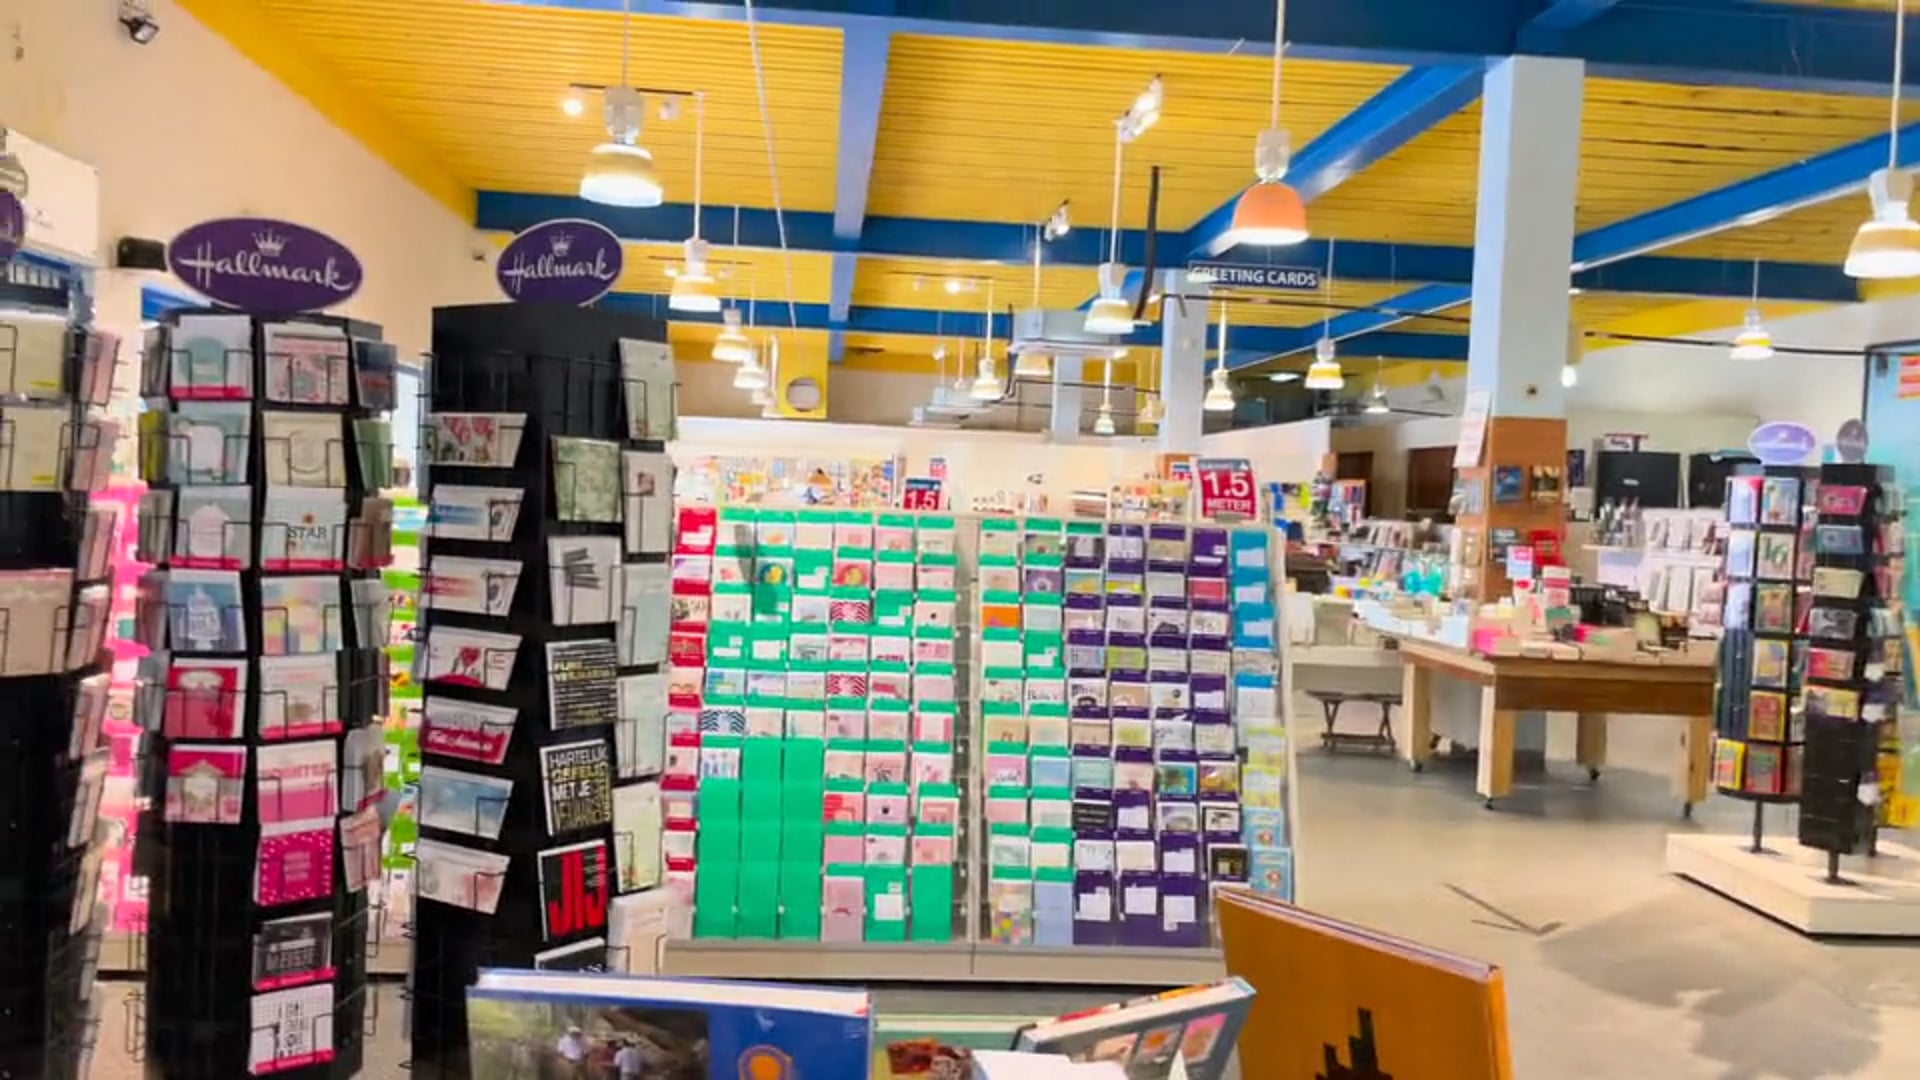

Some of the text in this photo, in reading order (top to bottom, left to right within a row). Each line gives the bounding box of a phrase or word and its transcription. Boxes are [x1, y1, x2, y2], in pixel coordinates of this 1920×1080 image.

[180, 242, 353, 292] Hallmark
[502, 248, 617, 293] Hallmark
[1267, 270, 1317, 287] CARDS
[1203, 472, 1250, 498] 1.5
[1205, 498, 1252, 511] METER
[287, 526, 327, 540] STAR
[551, 782, 576, 801] MET
[547, 845, 608, 938] JIJ
